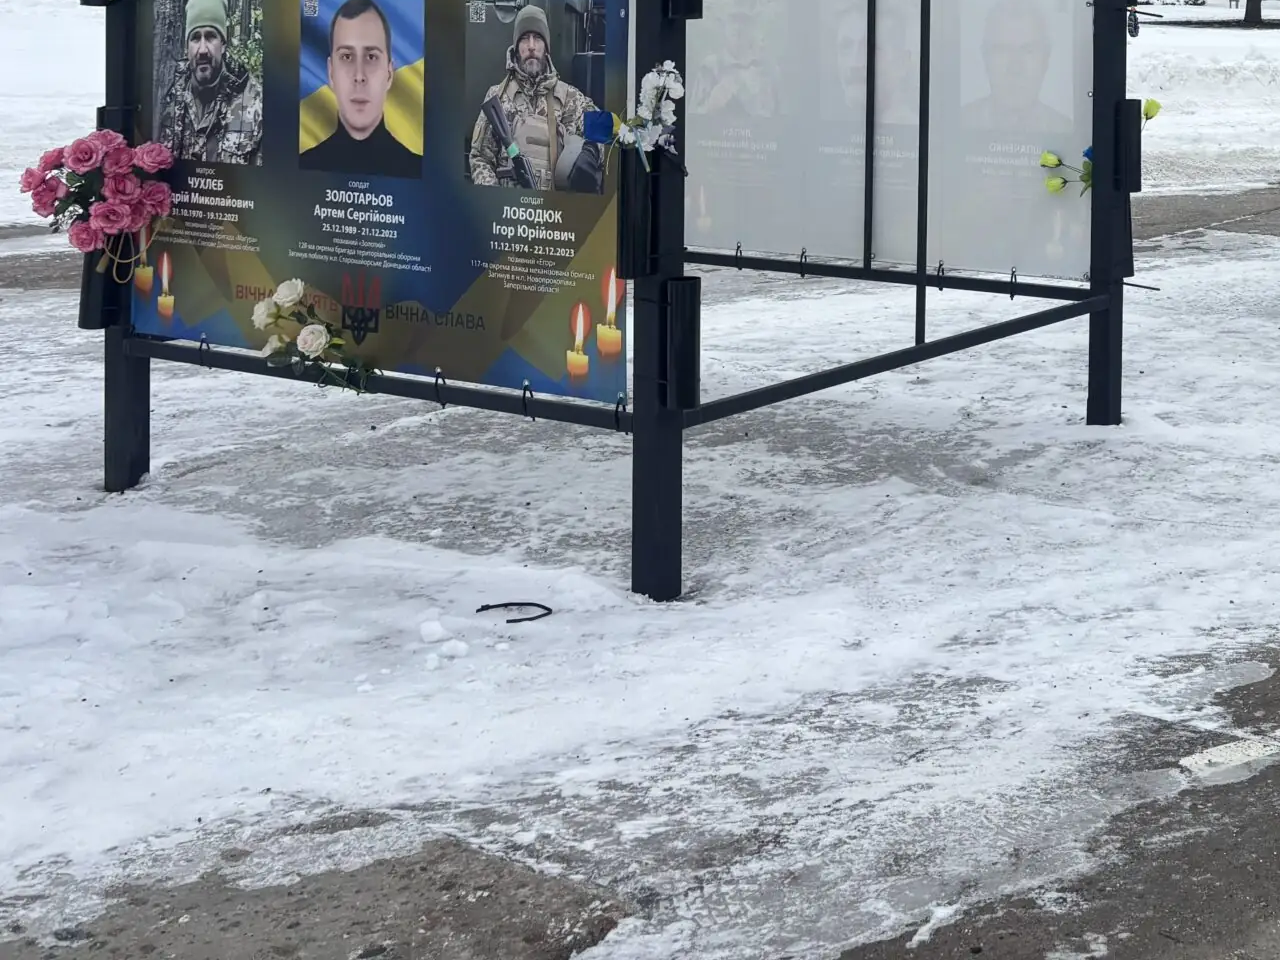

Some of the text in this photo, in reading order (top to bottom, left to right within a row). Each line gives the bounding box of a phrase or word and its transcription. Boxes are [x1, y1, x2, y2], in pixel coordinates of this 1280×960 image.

[188, 176, 224, 191] ЧУХЛЄБ
[348, 180, 370, 189] солдат
[190, 192, 255, 209] Миколайович
[325, 189, 394, 207] ЗОЛОТАРЬОВ
[520, 196, 544, 206] солдат
[172, 208, 239, 222] 31.10.1970 19.12.2023
[314, 204, 405, 225] Артем Сергійович
[502, 206, 563, 225] ЛОБОДЮК
[322, 223, 398, 239] 25.12.1989 21.12.2023
[492, 221, 576, 242] Ігор Юрійович
[490, 241, 575, 258] 11.12.1974 22.12.2023
[386, 302, 486, 331] ВІЧНА СЛАВА
